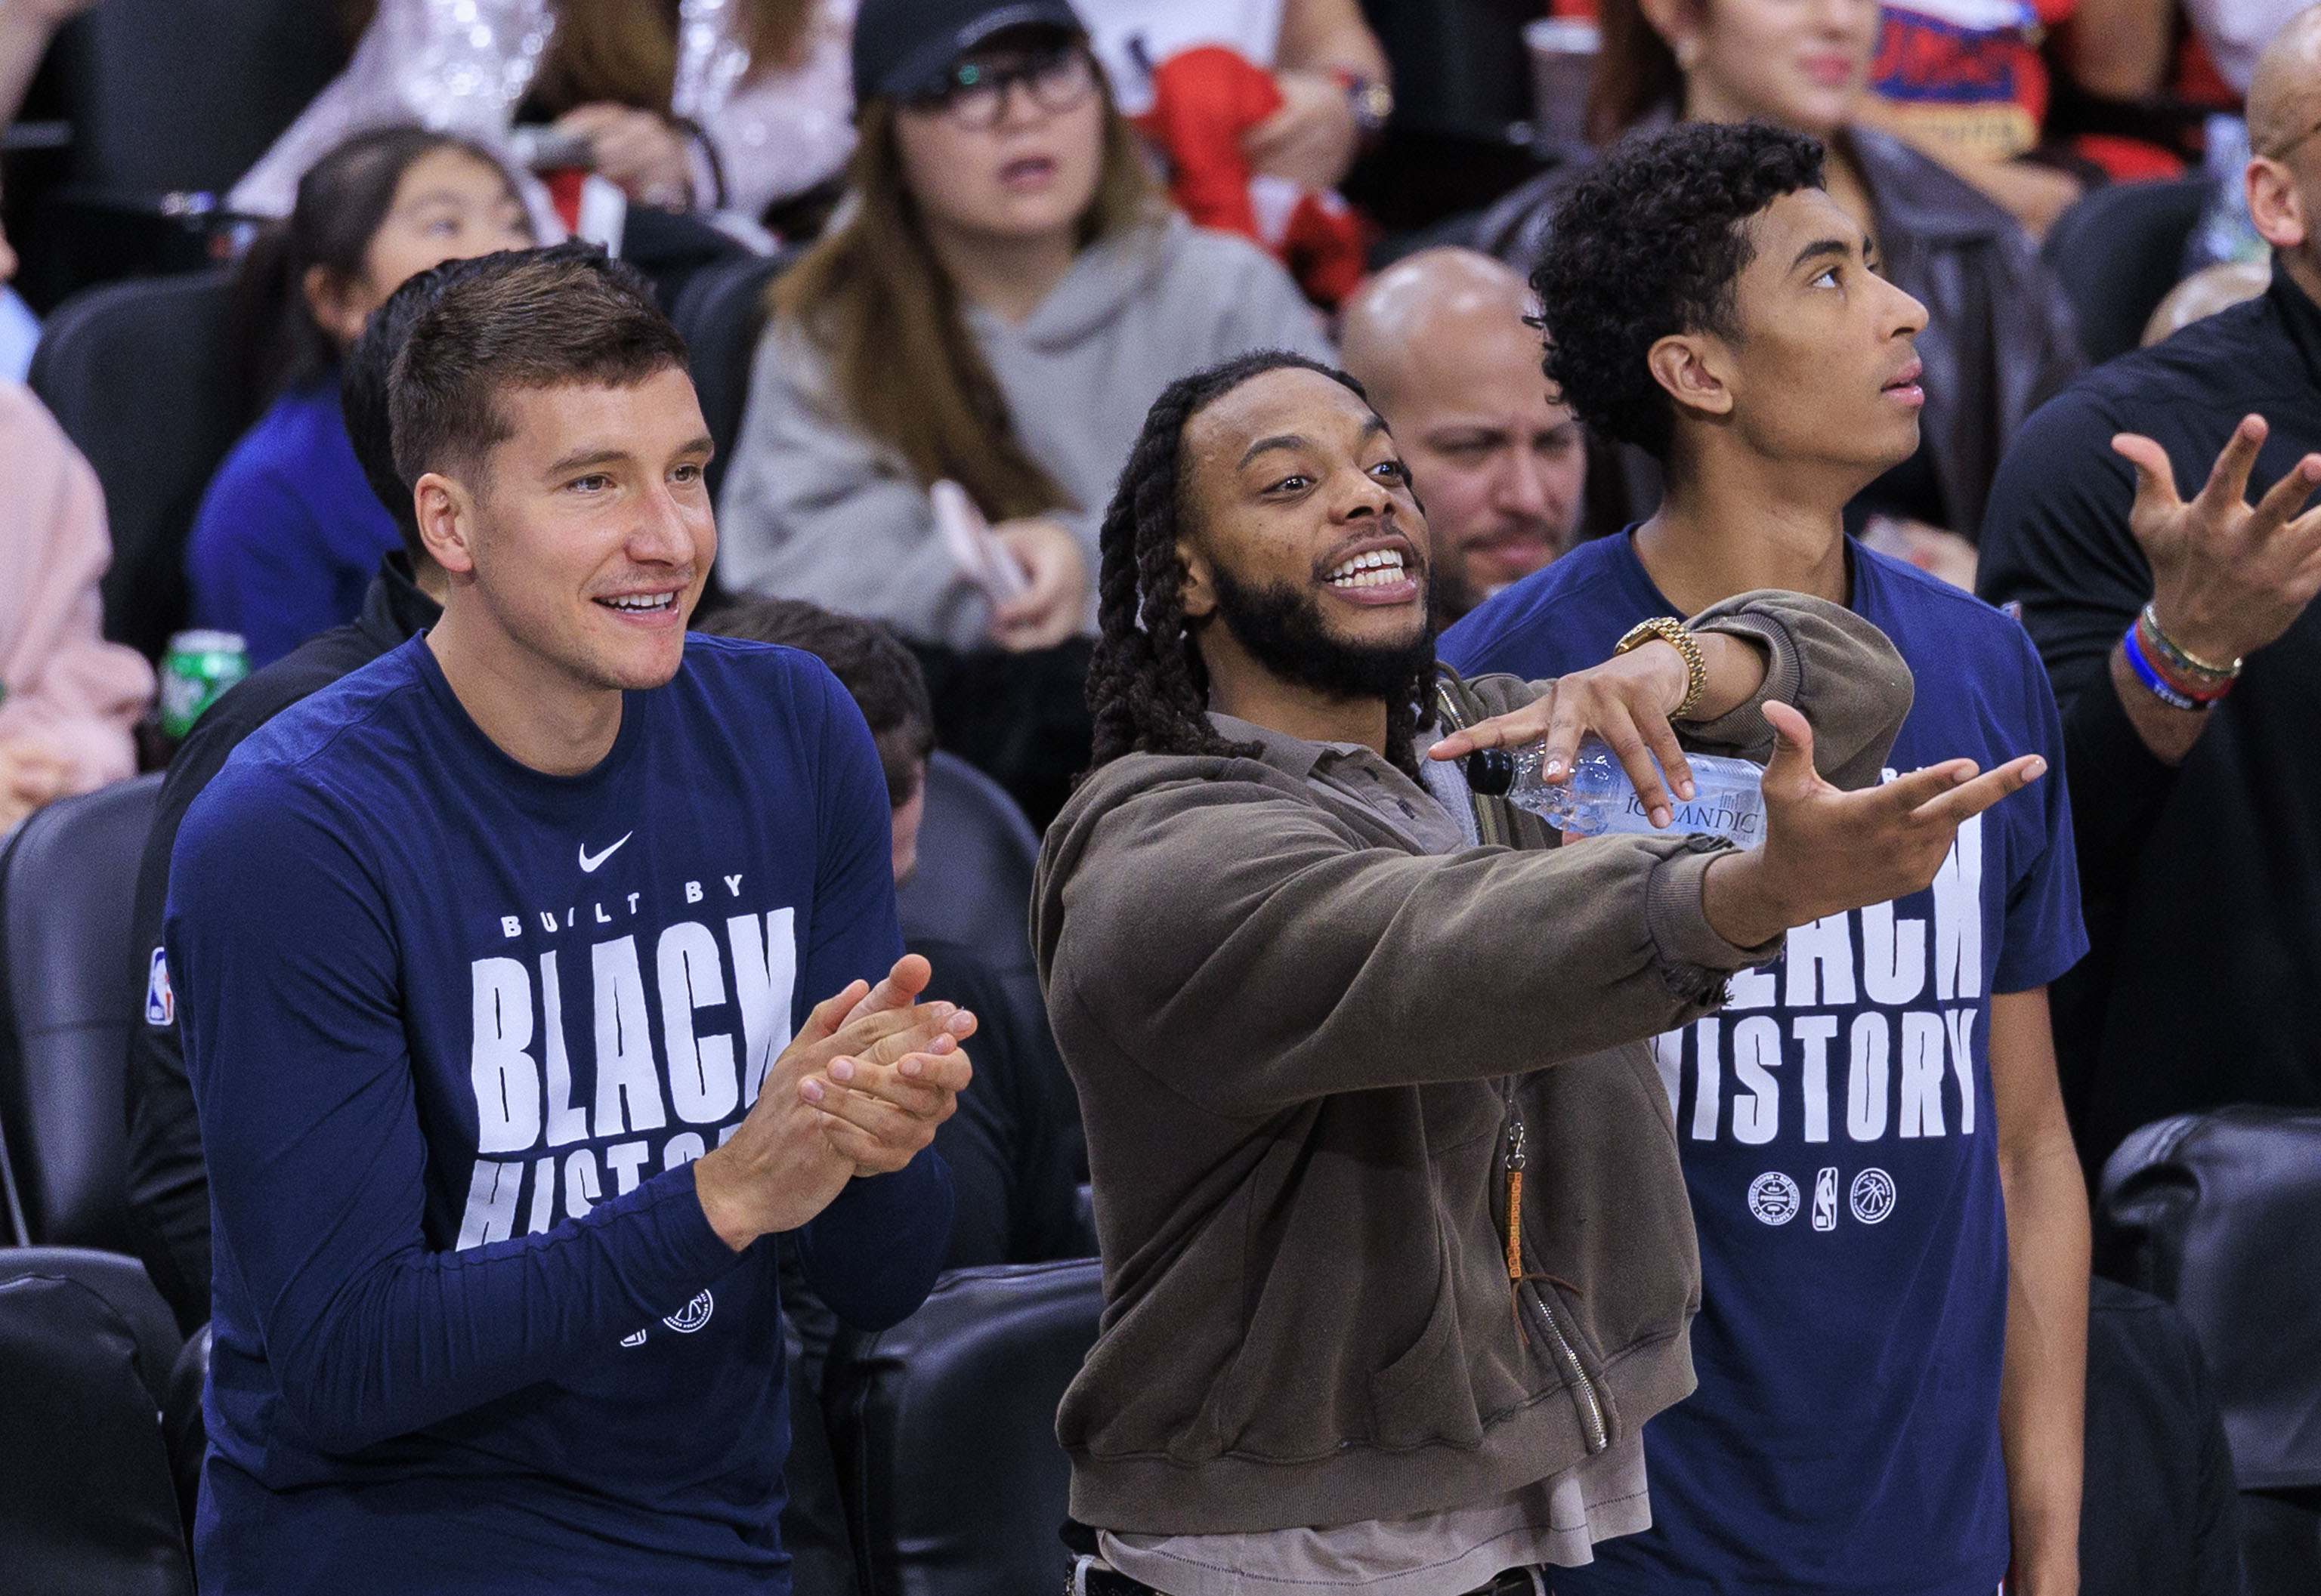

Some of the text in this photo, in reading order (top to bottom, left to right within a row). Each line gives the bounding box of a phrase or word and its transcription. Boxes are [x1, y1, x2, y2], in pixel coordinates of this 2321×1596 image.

[501, 874, 743, 938] BUILT BY
[471, 906, 797, 1153] BLACK
